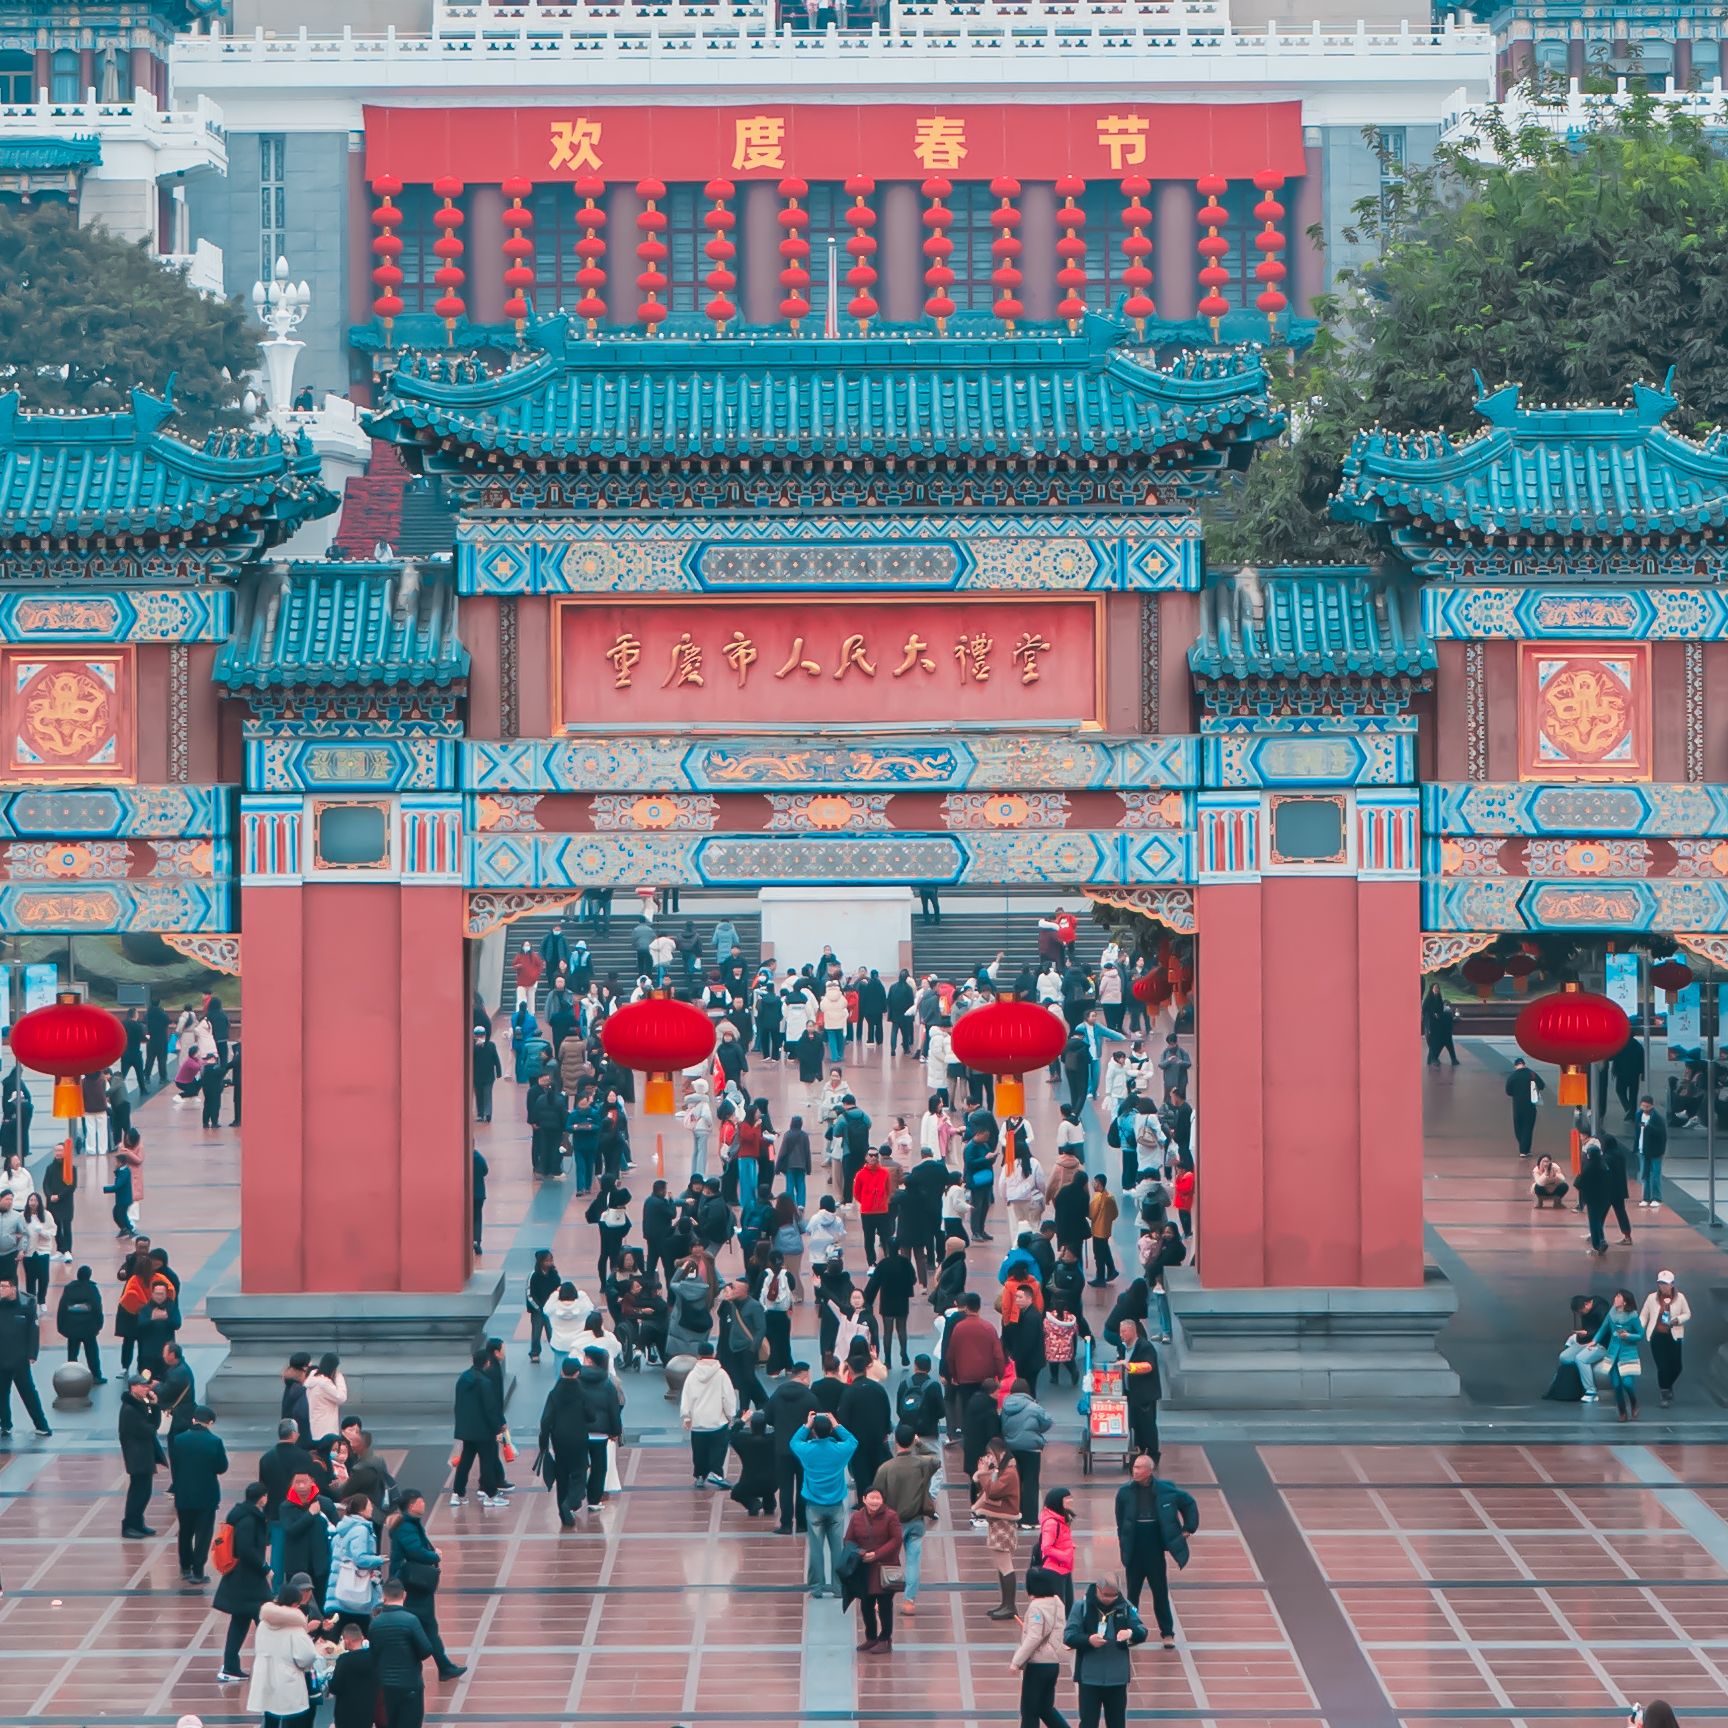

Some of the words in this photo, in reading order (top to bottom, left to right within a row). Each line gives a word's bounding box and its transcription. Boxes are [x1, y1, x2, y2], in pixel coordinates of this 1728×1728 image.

[548, 114, 1150, 171] 欢度春节
[605, 630, 1052, 689] 重慶市人民大禮堂
